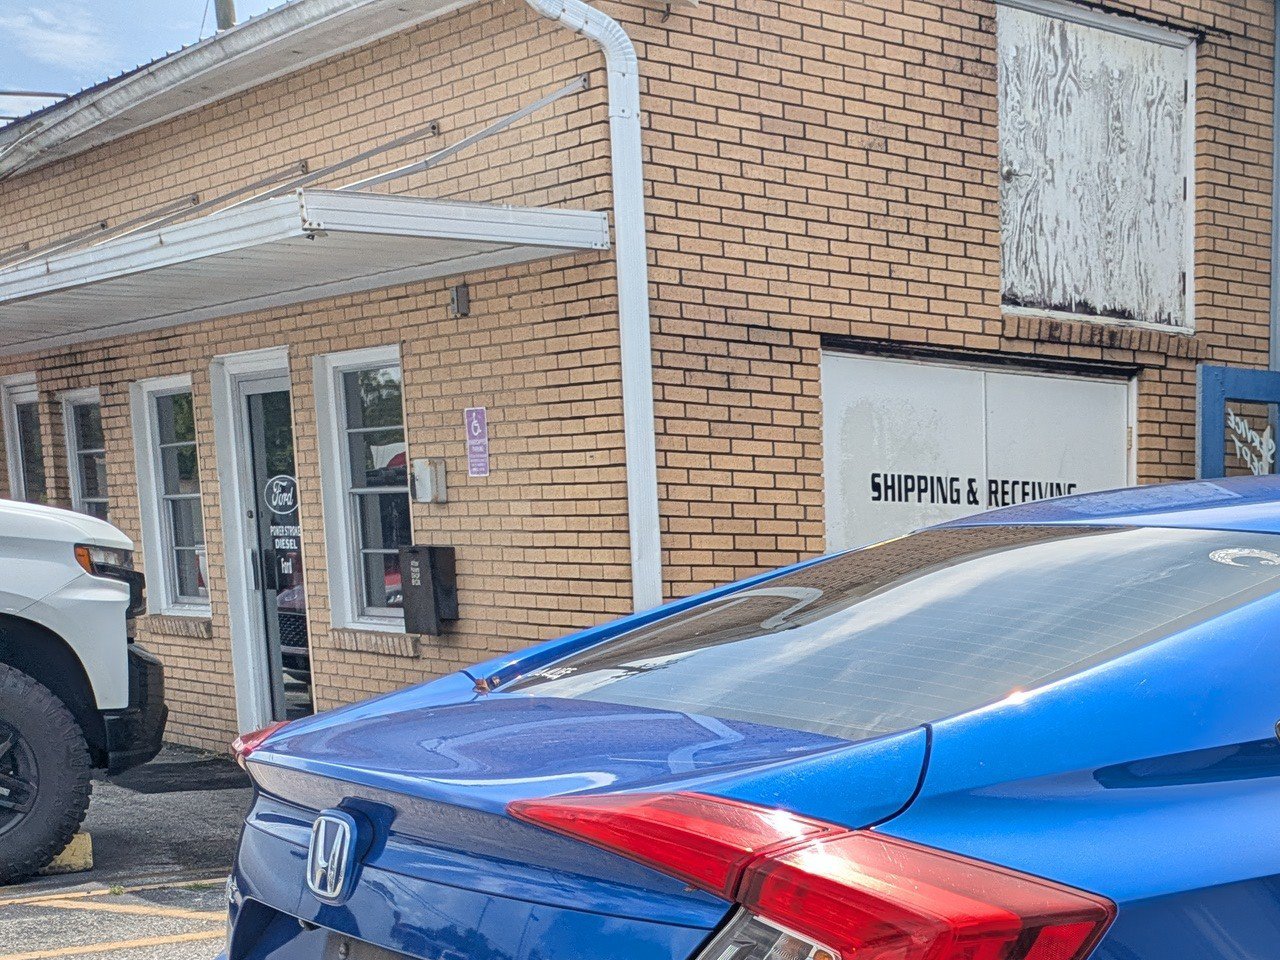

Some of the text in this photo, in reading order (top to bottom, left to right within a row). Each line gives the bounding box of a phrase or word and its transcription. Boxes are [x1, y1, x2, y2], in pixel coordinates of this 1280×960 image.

[271, 481, 294, 507] Ford
[871, 473, 961, 505] SHIPPING
[967, 477, 979, 506] &
[275, 538, 298, 550] DIESEL
